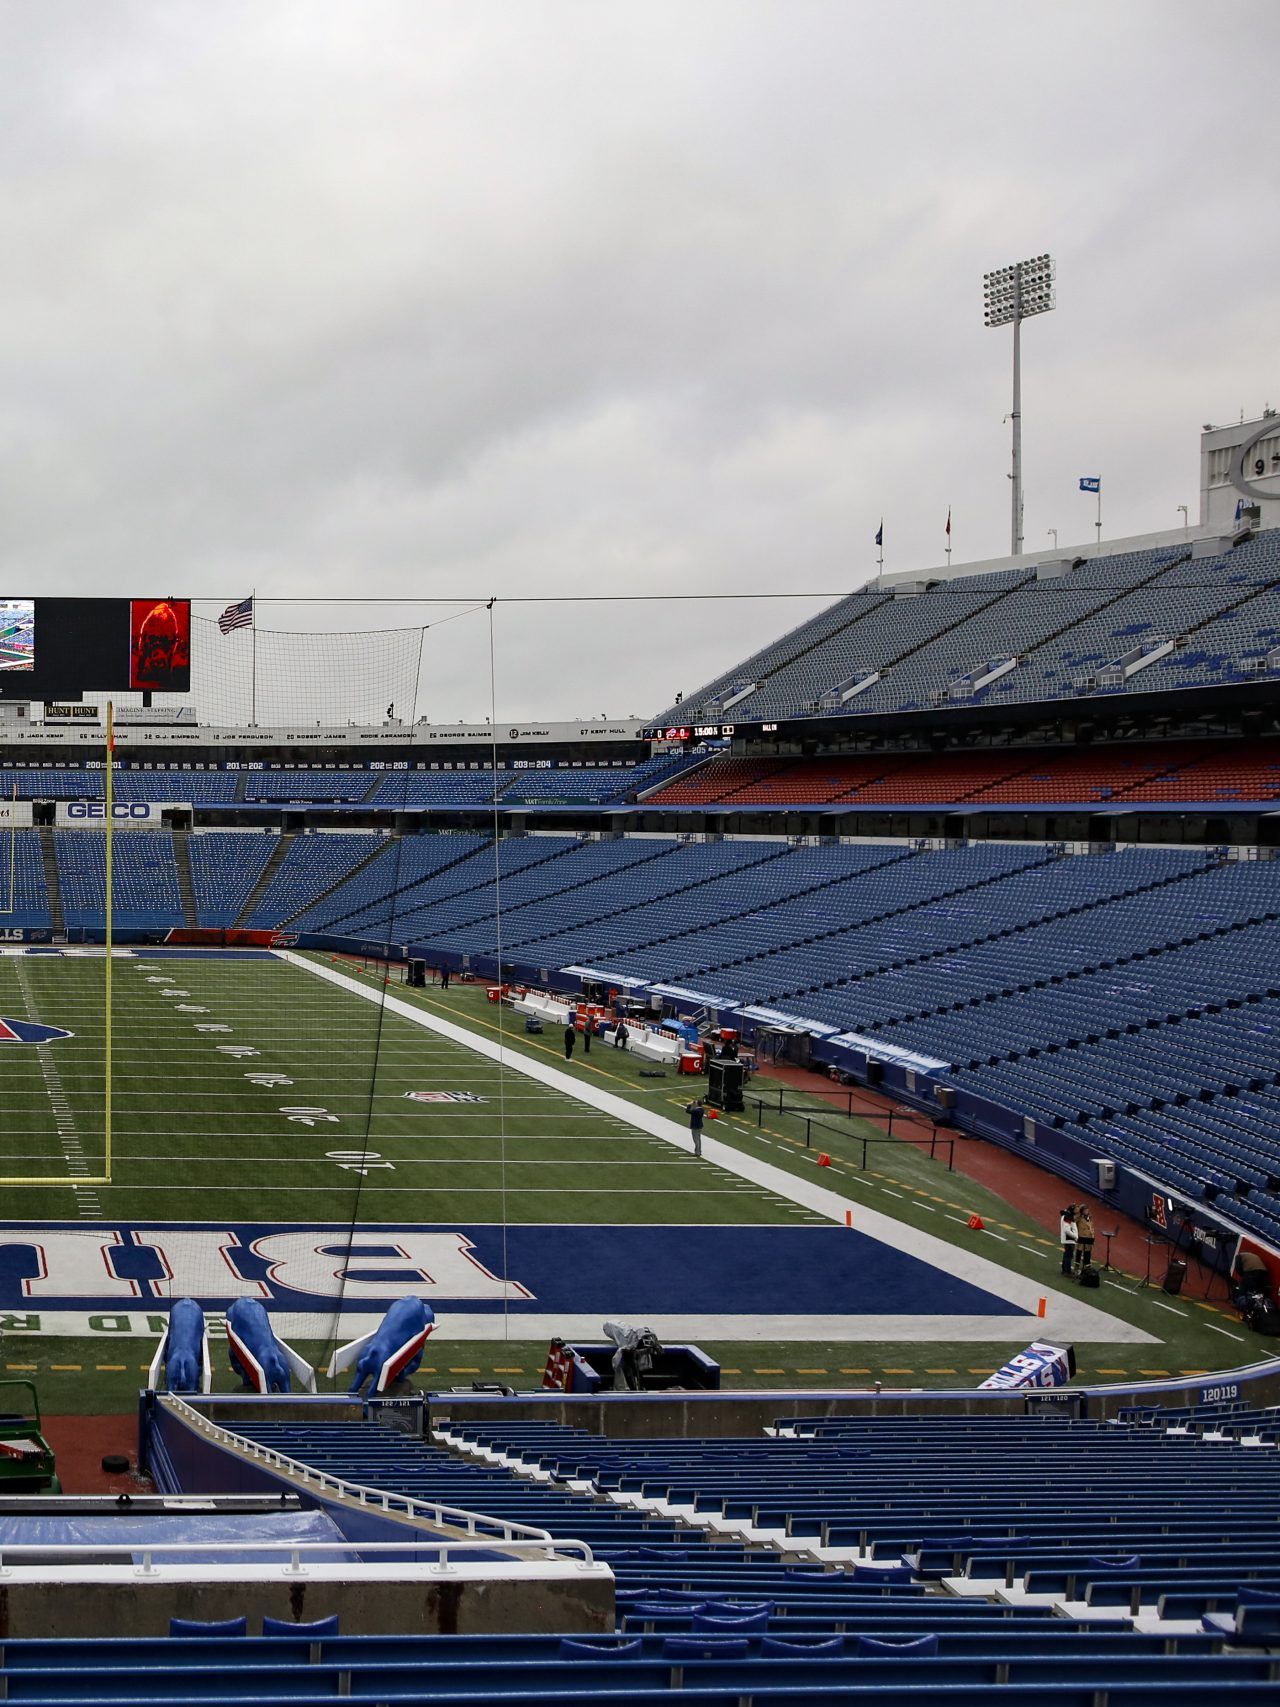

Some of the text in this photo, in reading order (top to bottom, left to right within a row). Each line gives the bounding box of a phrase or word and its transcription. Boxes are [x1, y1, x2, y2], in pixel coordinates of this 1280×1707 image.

[1255, 459, 1265, 475] 9
[48, 707, 70, 715] HUNT
[74, 707, 96, 715] HUNT
[657, 730, 662, 738] 0
[679, 728, 685, 737] 0
[694, 727, 713, 736] 15:00
[691, 746, 706, 754] 205
[86, 761, 101, 769] 200
[111, 761, 122, 769] 01
[226, 762, 240, 770] 201
[248, 762, 263, 770] 202
[370, 762, 385, 770] 202
[393, 762, 408, 770] 203
[513, 760, 528, 768] 203
[536, 760, 551, 768] 204
[489, 992, 496, 1000] G
[693, 1059, 701, 1069] G
[279, 1107, 340, 1122] 20
[325, 1151, 396, 1170] 10
[1203, 1385, 1238, 1402] 120 119
